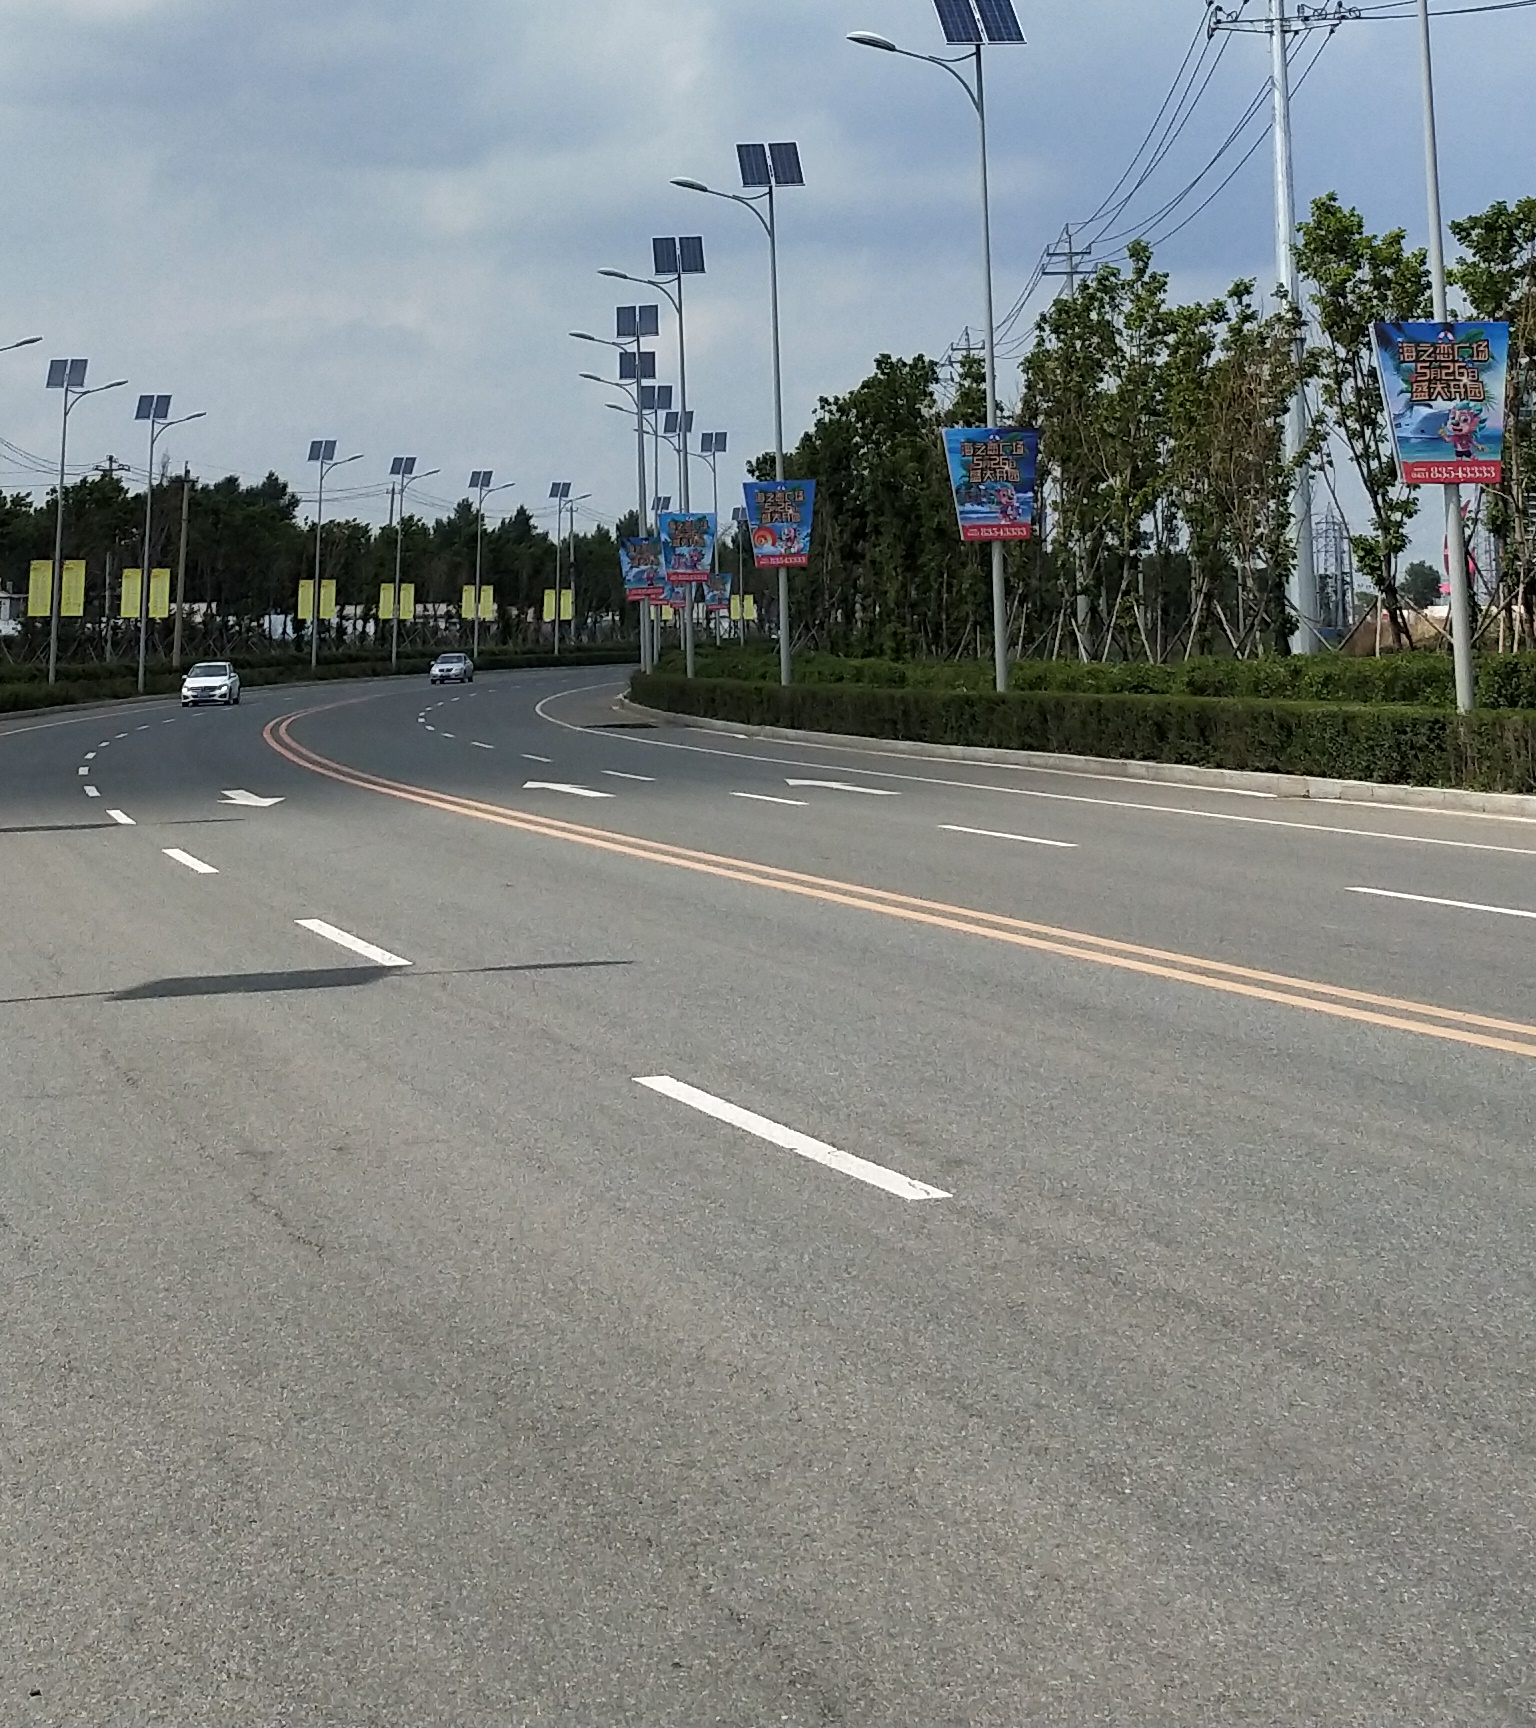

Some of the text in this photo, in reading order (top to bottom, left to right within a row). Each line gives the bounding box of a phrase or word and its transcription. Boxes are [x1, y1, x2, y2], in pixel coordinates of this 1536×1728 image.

[1398, 340, 1489, 361] 海之恋广场
[1415, 362, 1479, 381] 5月26日
[1411, 381, 1484, 401] 盛大开园
